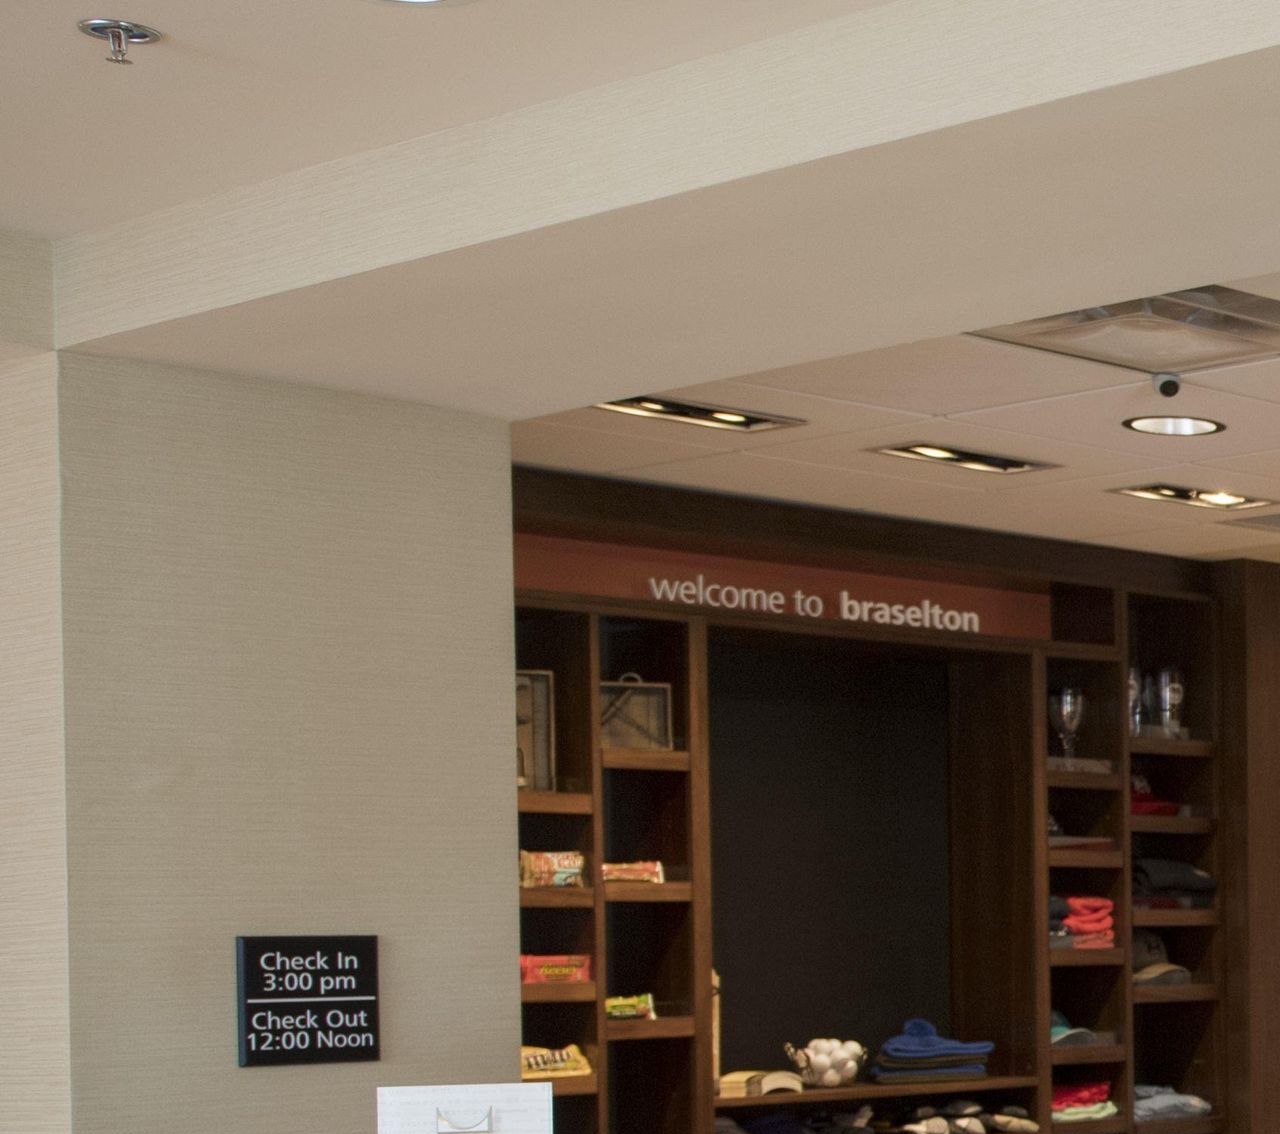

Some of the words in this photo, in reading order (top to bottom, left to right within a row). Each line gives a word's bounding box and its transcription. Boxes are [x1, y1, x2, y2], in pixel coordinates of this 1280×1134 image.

[649, 574, 785, 614] welcome
[794, 589, 824, 618] to
[839, 590, 981, 633] braselton
[260, 951, 329, 971] Check
[337, 951, 358, 970] In
[263, 972, 313, 992] 3:00
[320, 975, 356, 995] pm
[252, 1009, 319, 1030] Check
[326, 1010, 368, 1028] Out
[247, 1031, 310, 1051] 12:00
[317, 1030, 374, 1048] Noon
